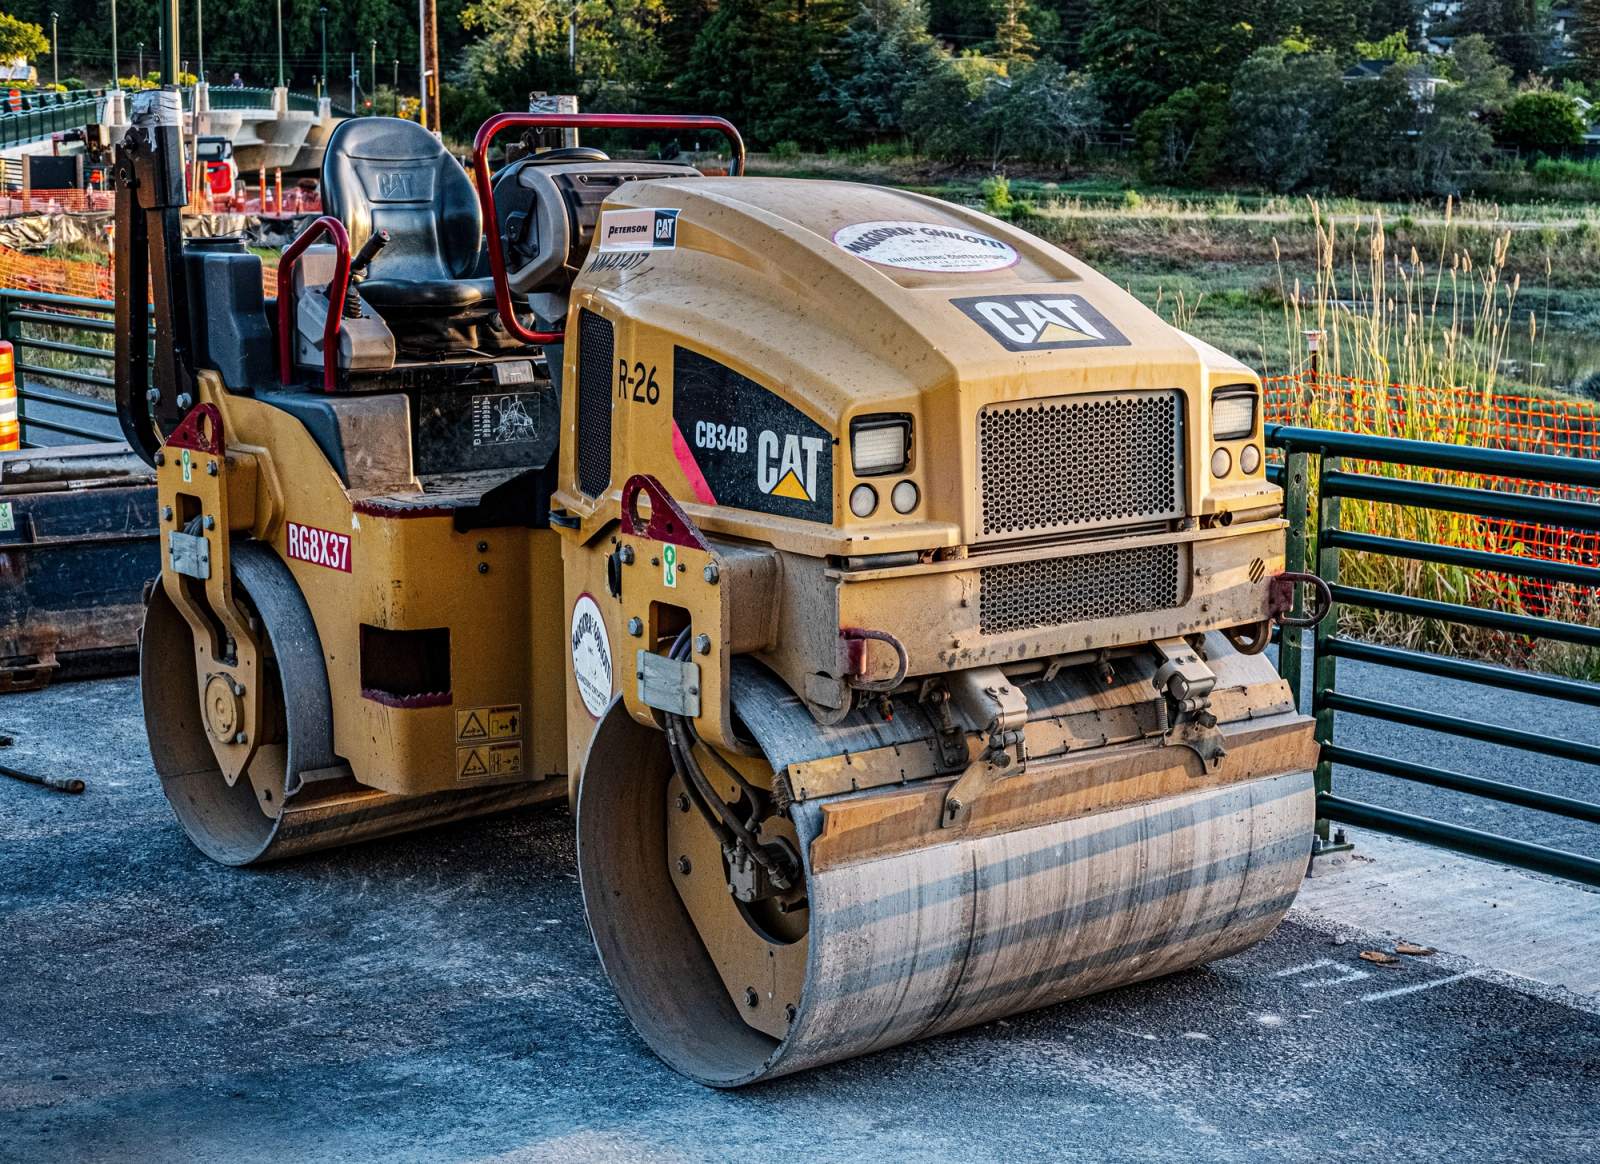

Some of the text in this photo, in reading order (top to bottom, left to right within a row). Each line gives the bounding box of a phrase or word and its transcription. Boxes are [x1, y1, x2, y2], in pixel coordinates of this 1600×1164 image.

[376, 173, 416, 199] CAT
[608, 225, 648, 238] PETERSON
[656, 219, 674, 239] CAT
[920, 228, 1006, 250] GHILOTTI
[975, 300, 1106, 344] CAT
[618, 359, 660, 405] R-26
[695, 420, 748, 454] CB34B
[757, 430, 823, 502] CAT
[288, 523, 349, 570] RG8X37
